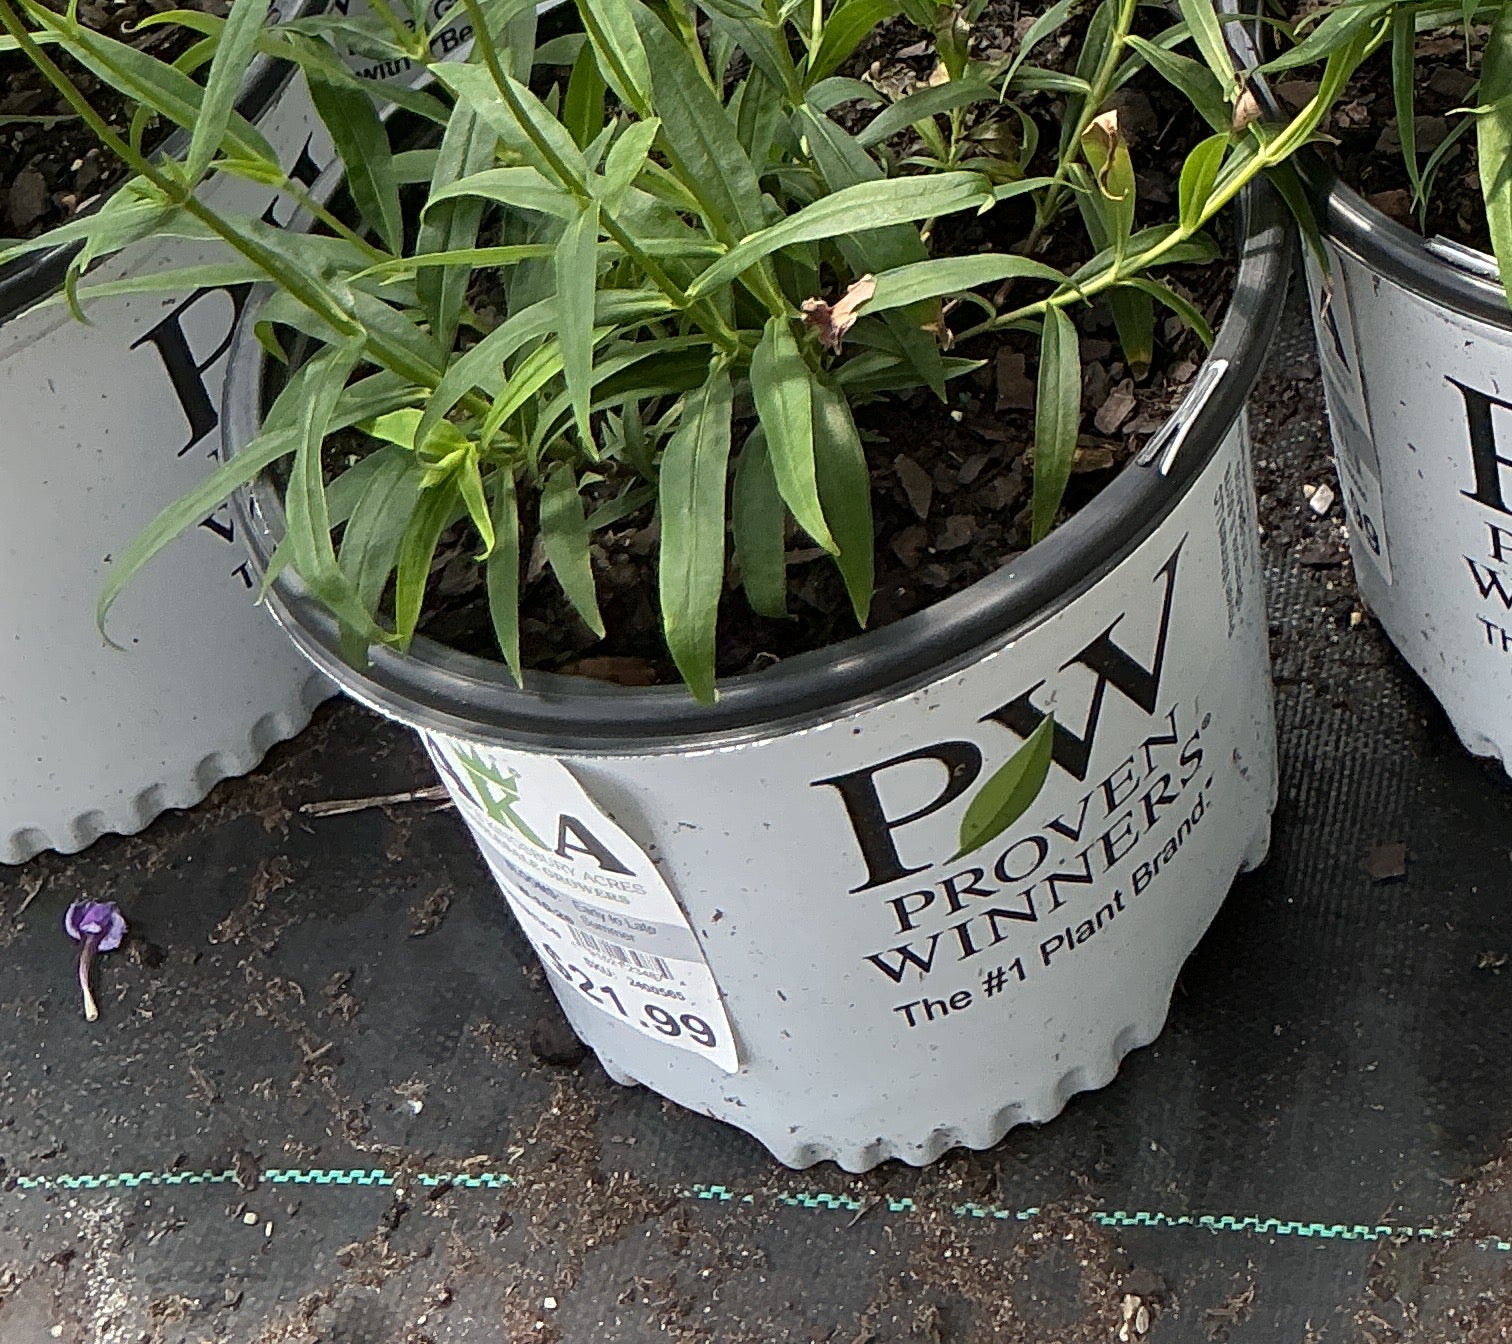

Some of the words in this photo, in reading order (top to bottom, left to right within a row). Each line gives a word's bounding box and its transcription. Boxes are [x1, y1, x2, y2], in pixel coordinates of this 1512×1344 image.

[810, 531, 1188, 894] PW
[583, 871, 647, 896] ACRES
[884, 704, 1180, 935] PROVEN
[542, 943, 717, 1048] $21.99
[894, 990, 972, 1027] The
[981, 958, 1027, 999] #1
[1039, 892, 1126, 967] Plant
